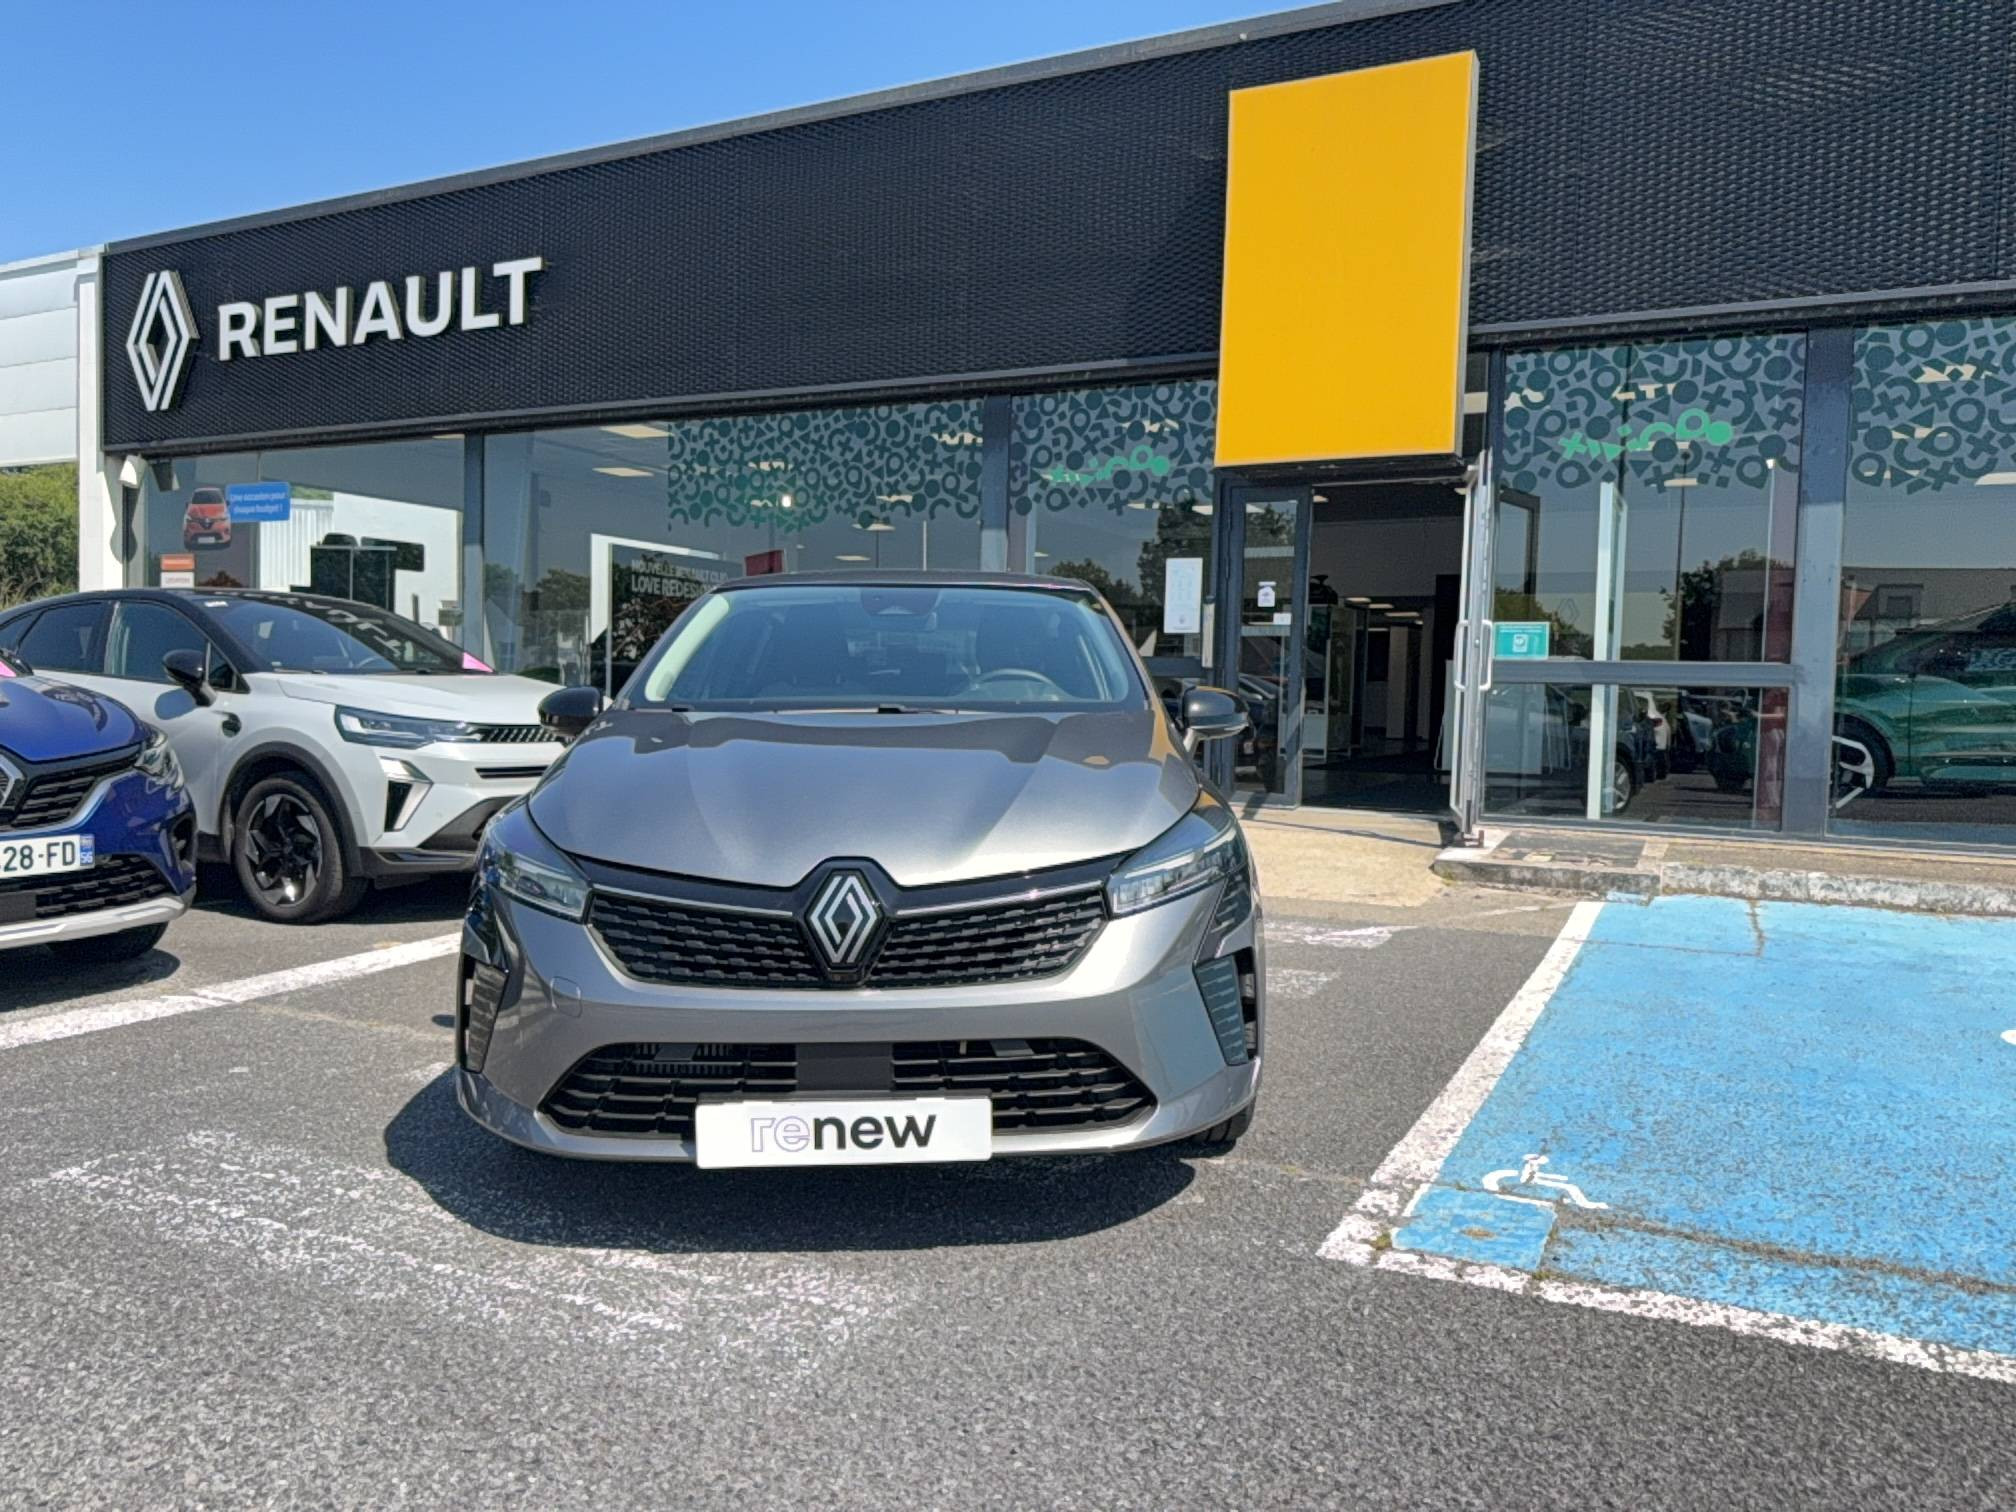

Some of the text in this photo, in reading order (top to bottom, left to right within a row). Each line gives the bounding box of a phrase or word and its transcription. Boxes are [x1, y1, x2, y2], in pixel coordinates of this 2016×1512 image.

[218, 256, 542, 362] RENAULT
[631, 573, 660, 595] LOVE
[0, 840, 76, 872] 28-FD
[751, 1114, 937, 1153] renew
